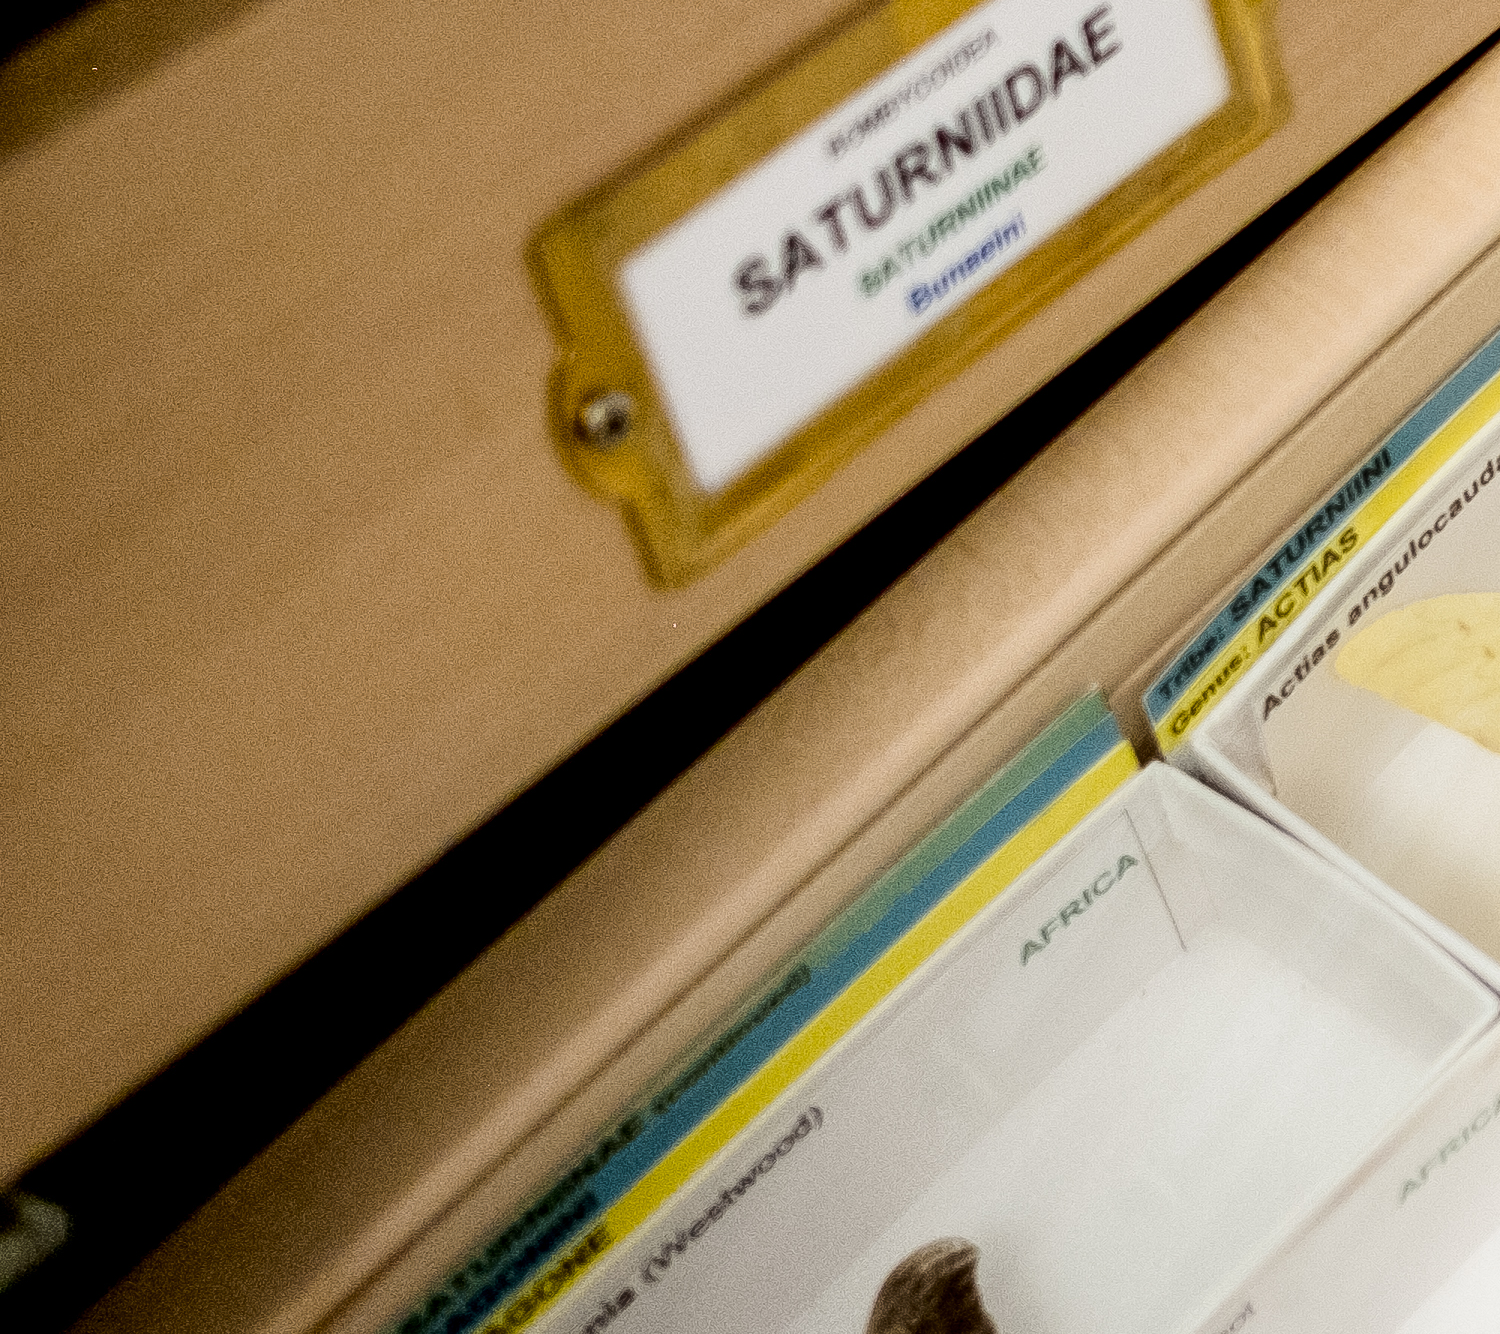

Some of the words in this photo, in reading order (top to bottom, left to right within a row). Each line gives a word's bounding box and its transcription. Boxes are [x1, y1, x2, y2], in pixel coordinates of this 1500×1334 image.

[734, 3, 1123, 316] SATURNIIDAE
[1230, 447, 1391, 622] SATURNIINI
[1170, 646, 1250, 737] Genus:
[1257, 526, 1359, 644] ACTIAS
[1264, 629, 1340, 721] Actias
[1018, 852, 1138, 966] AFRICA
[642, 1106, 824, 1283] (Westwood)
